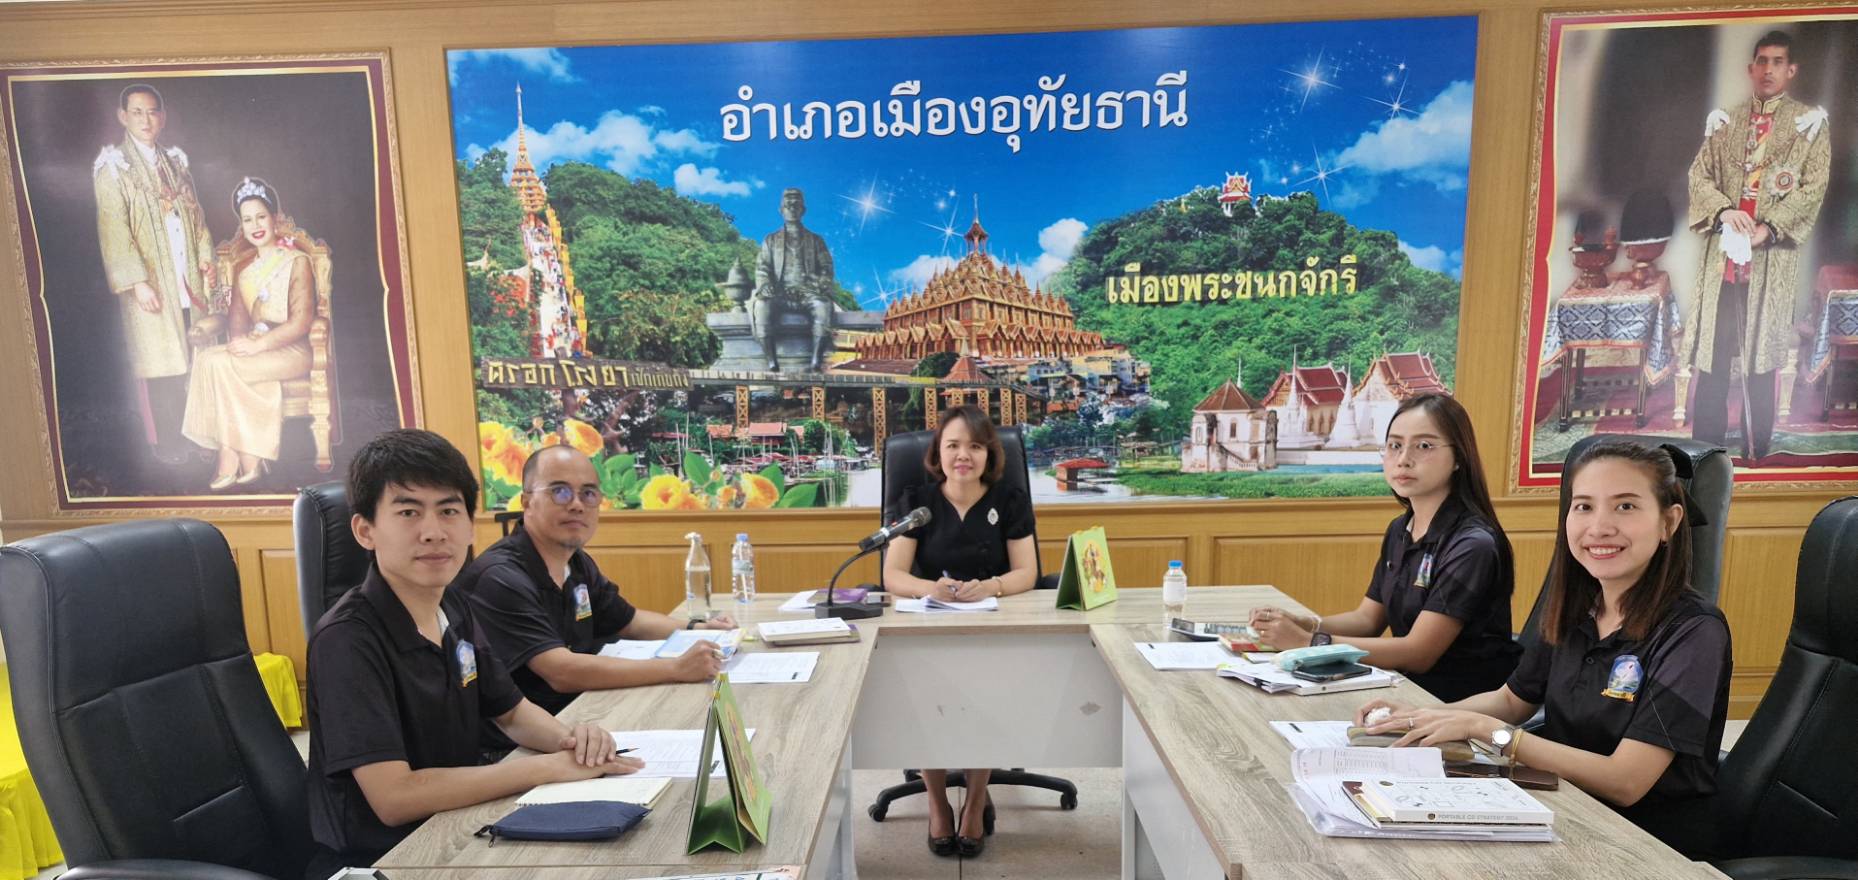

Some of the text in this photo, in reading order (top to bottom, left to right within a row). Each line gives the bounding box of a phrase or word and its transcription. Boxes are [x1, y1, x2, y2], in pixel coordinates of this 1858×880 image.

[719, 70, 1188, 154] อำเภอเมืองอุทัยธานี
